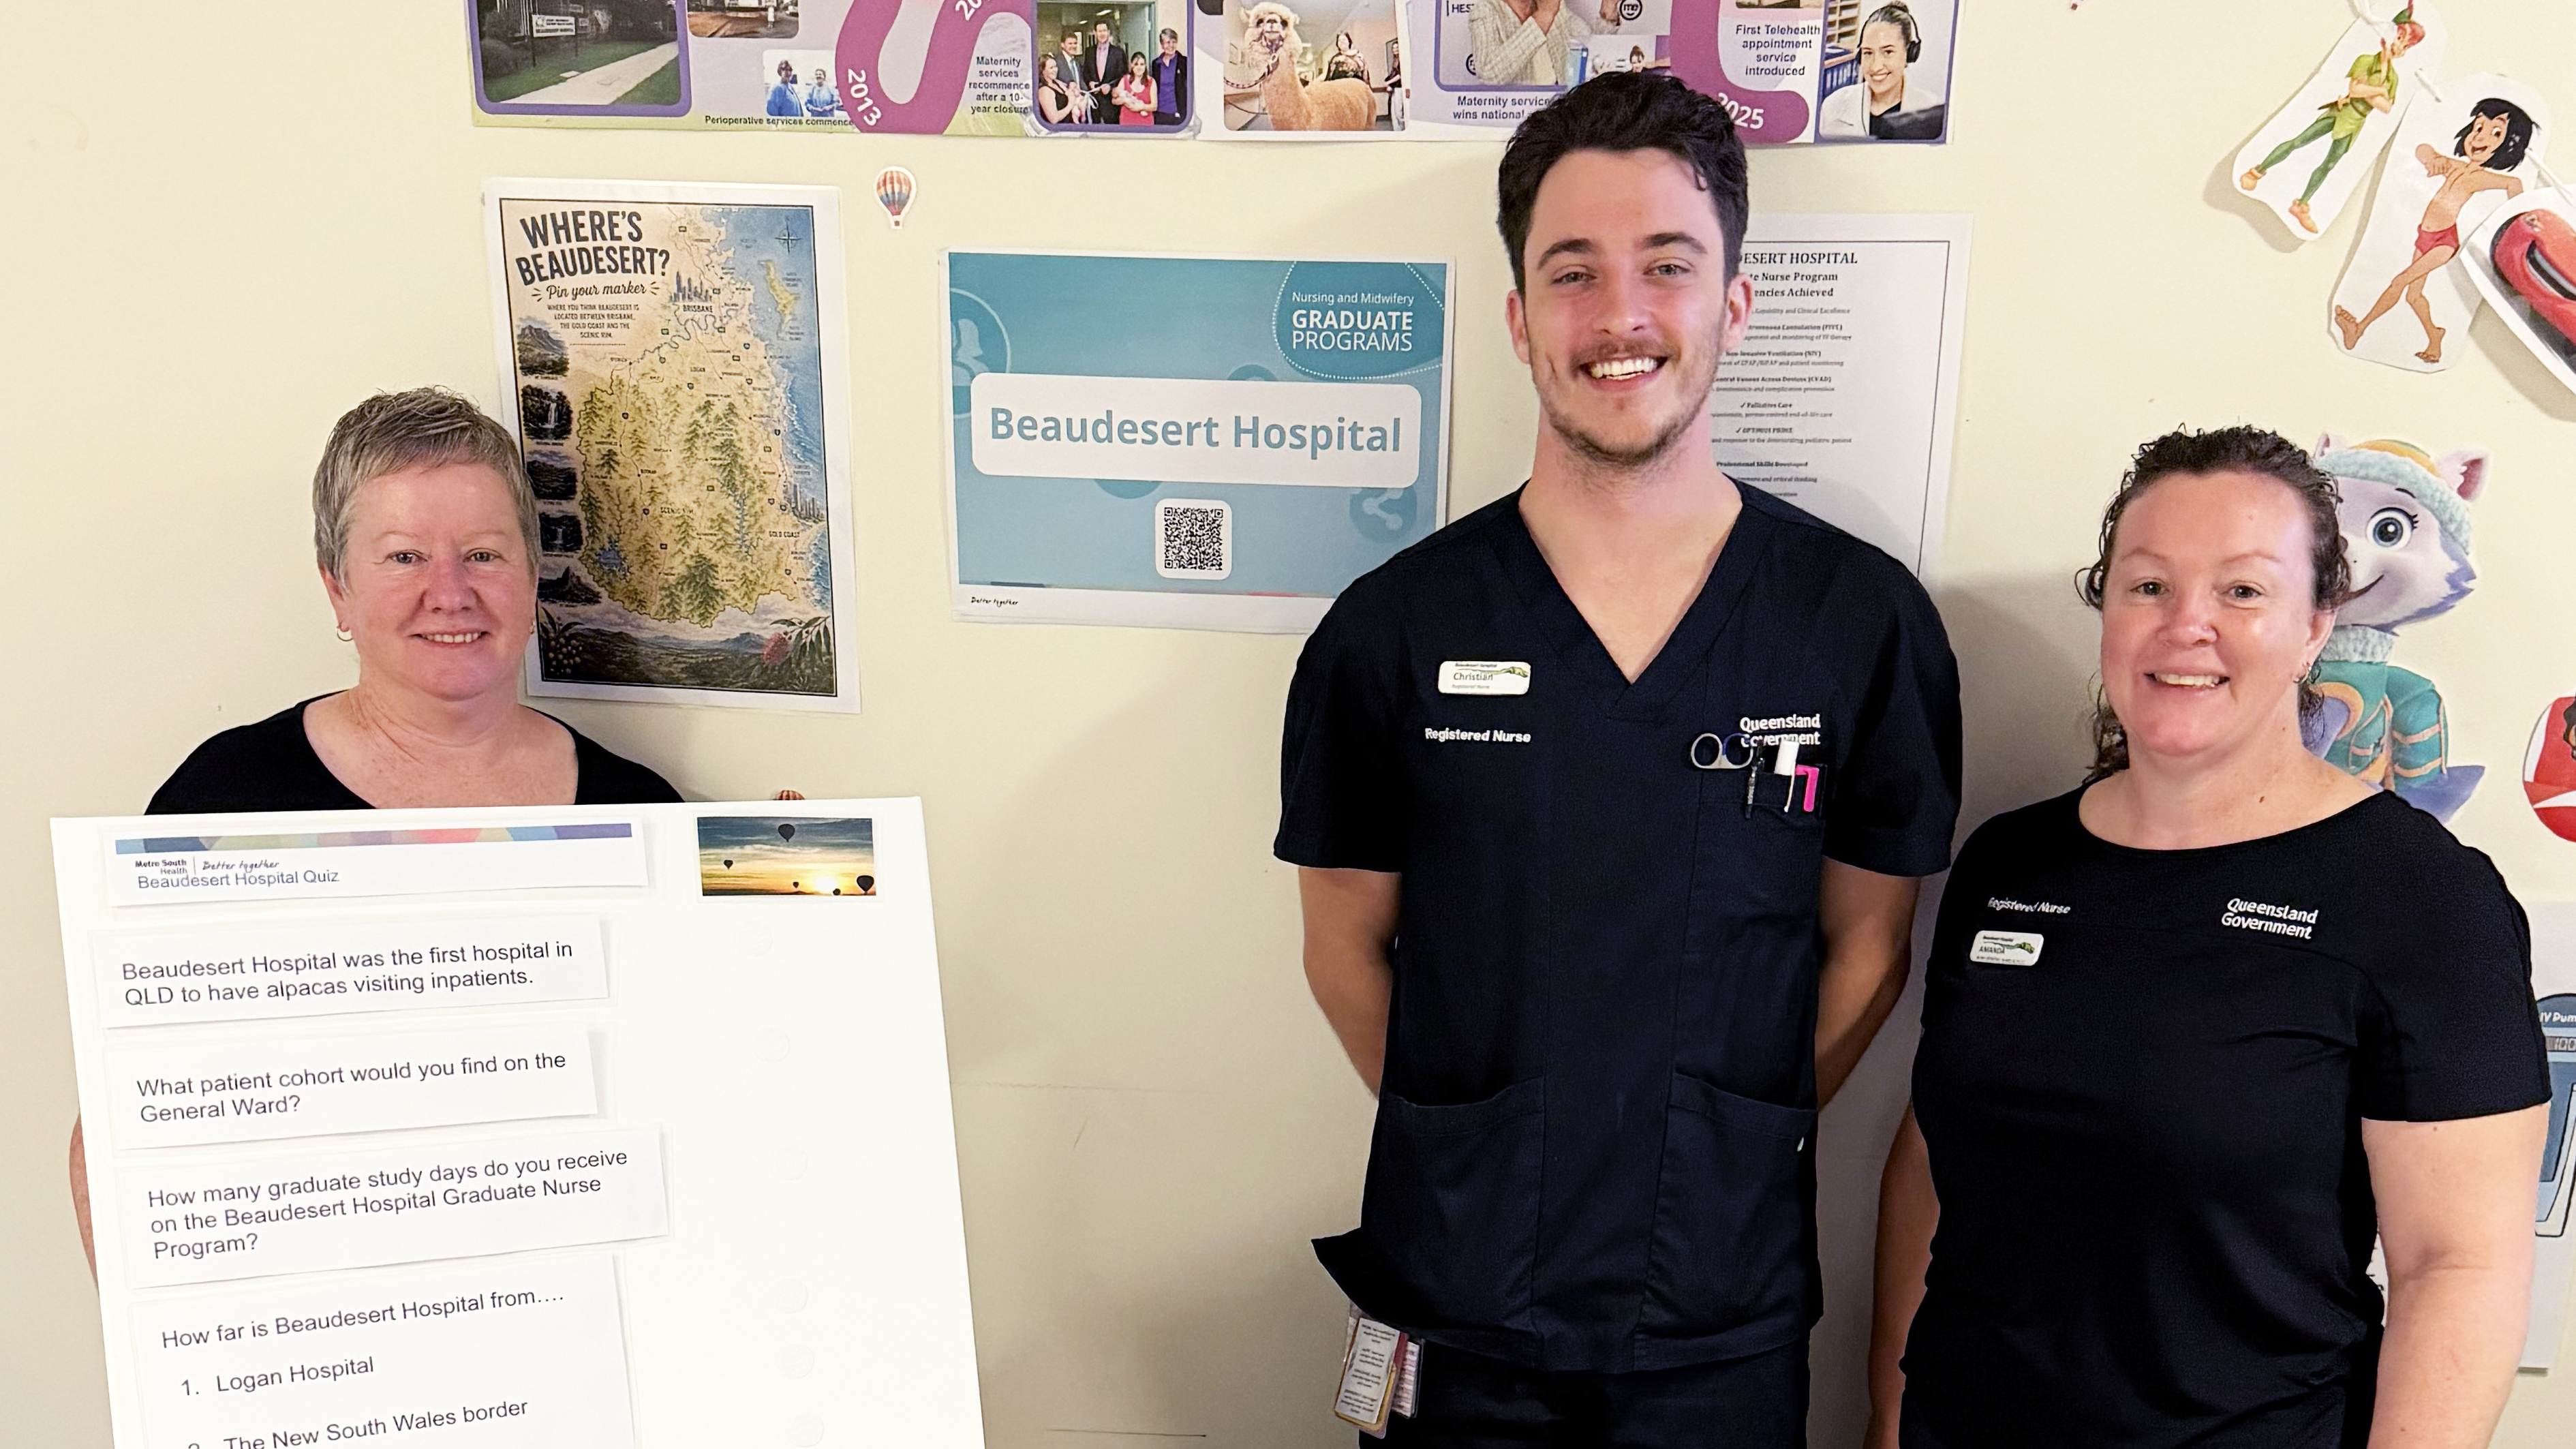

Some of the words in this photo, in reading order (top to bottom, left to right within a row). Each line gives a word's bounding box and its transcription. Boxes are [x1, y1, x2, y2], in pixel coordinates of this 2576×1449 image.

[1736, 25, 1761, 34] First
[1765, 25, 1820, 35] Telehealth
[1742, 39, 1812, 50] appointment
[977, 57, 1021, 67] Maternity
[1756, 52, 1796, 62] service
[979, 69, 1019, 78] services
[1745, 66, 1805, 76] introduced
[848, 68, 882, 127] 2013
[976, 92, 998, 102] after
[1009, 93, 1024, 102] 10-
[1457, 95, 1508, 108] Maternity
[970, 105, 991, 115] year
[994, 104, 1029, 115] closure
[1453, 109, 1477, 119] wins
[1482, 109, 1524, 119] national
[705, 115, 764, 125] Perioperative
[766, 117, 803, 126] services
[515, 245, 670, 286] BEAUDESERT?
[1790, 252, 1858, 264] HOSPITAL
[1761, 273, 1790, 281] Nurse
[1794, 272, 1838, 283] Program
[547, 285, 570, 300] Pin
[572, 286, 600, 301] your
[602, 280, 647, 295] marker
[1292, 291, 1335, 305] Nursing
[1337, 292, 1359, 305] and
[1361, 292, 1415, 307] Midwifery
[1787, 288, 1834, 296] Achieved
[683, 305, 713, 313] BRISBANE
[1292, 309, 1413, 331] GRADUATE
[1292, 331, 1413, 352] PROGRAMS
[991, 408, 1219, 449] Beaudesert
[1233, 416, 1401, 460] Hospital
[1453, 672, 1493, 681] Christian
[1740, 713, 1821, 733] Queensland
[1425, 727, 1490, 742] Registered
[1492, 729, 1531, 743] Nurse
[202, 860, 236, 870] Better
[239, 859, 279, 873] together
[138, 874, 230, 889] Beaudesert
[235, 871, 298, 887] Hospital
[303, 870, 339, 885] Quiz
[2038, 901, 2071, 914] Nurse
[2227, 898, 2319, 924] Queensland
[2221, 912, 2312, 939] Government
[123, 958, 245, 980] Beaudesert
[252, 952, 337, 975] Hospital
[343, 952, 385, 967] was
[391, 948, 423, 966] the
[429, 946, 467, 963] first
[473, 941, 550, 963] hospital
[556, 940, 572, 957] in
[125, 986, 174, 1007] QLD
[181, 984, 202, 1003] to
[208, 981, 260, 1001] have
[266, 977, 348, 1001] alpacas
[353, 974, 425, 995] visiting
[431, 967, 534, 991] inpatients.
[138, 1076, 195, 1097] What
[200, 1071, 273, 1096] patient
[279, 1067, 345, 1088] cohort
[350, 1062, 412, 1082] would
[417, 1063, 455, 1082] you
[461, 1054, 497, 1073] find
[504, 1056, 529, 1071] on
[534, 1051, 567, 1069] the
[140, 1099, 226, 1123] General
[232, 1095, 301, 1118] Ward?
[148, 1188, 196, 1207] How
[203, 1184, 262, 1205] many
[268, 1172, 361, 1201] graduate
[367, 1166, 424, 1190] study
[429, 1161, 478, 1183] days
[484, 1158, 509, 1177] do
[515, 1157, 551, 1176] you
[557, 1148, 628, 1171] receive
[150, 1217, 178, 1233] on
[184, 1210, 218, 1230] the
[225, 1198, 347, 1227] Beaudesert
[353, 1191, 438, 1217] Hospital
[442, 1180, 537, 1205] Graduate
[542, 1175, 602, 1198] Nurse
[154, 1232, 260, 1260] Program?
[162, 1329, 210, 1350] How
[216, 1322, 245, 1343] far
[251, 1320, 270, 1338] is
[275, 1305, 397, 1336] Beaudesert
[402, 1293, 486, 1322] Hospital
[490, 1287, 564, 1309] from....
[181, 1377, 200, 1397] 1.
[216, 1369, 283, 1394] Logan
[290, 1356, 375, 1384] Hospital
[224, 1435, 266, 1449] The
[272, 1427, 320, 1447] New
[326, 1417, 388, 1444] South
[394, 1409, 458, 1432] Wales
[463, 1399, 529, 1424] border
